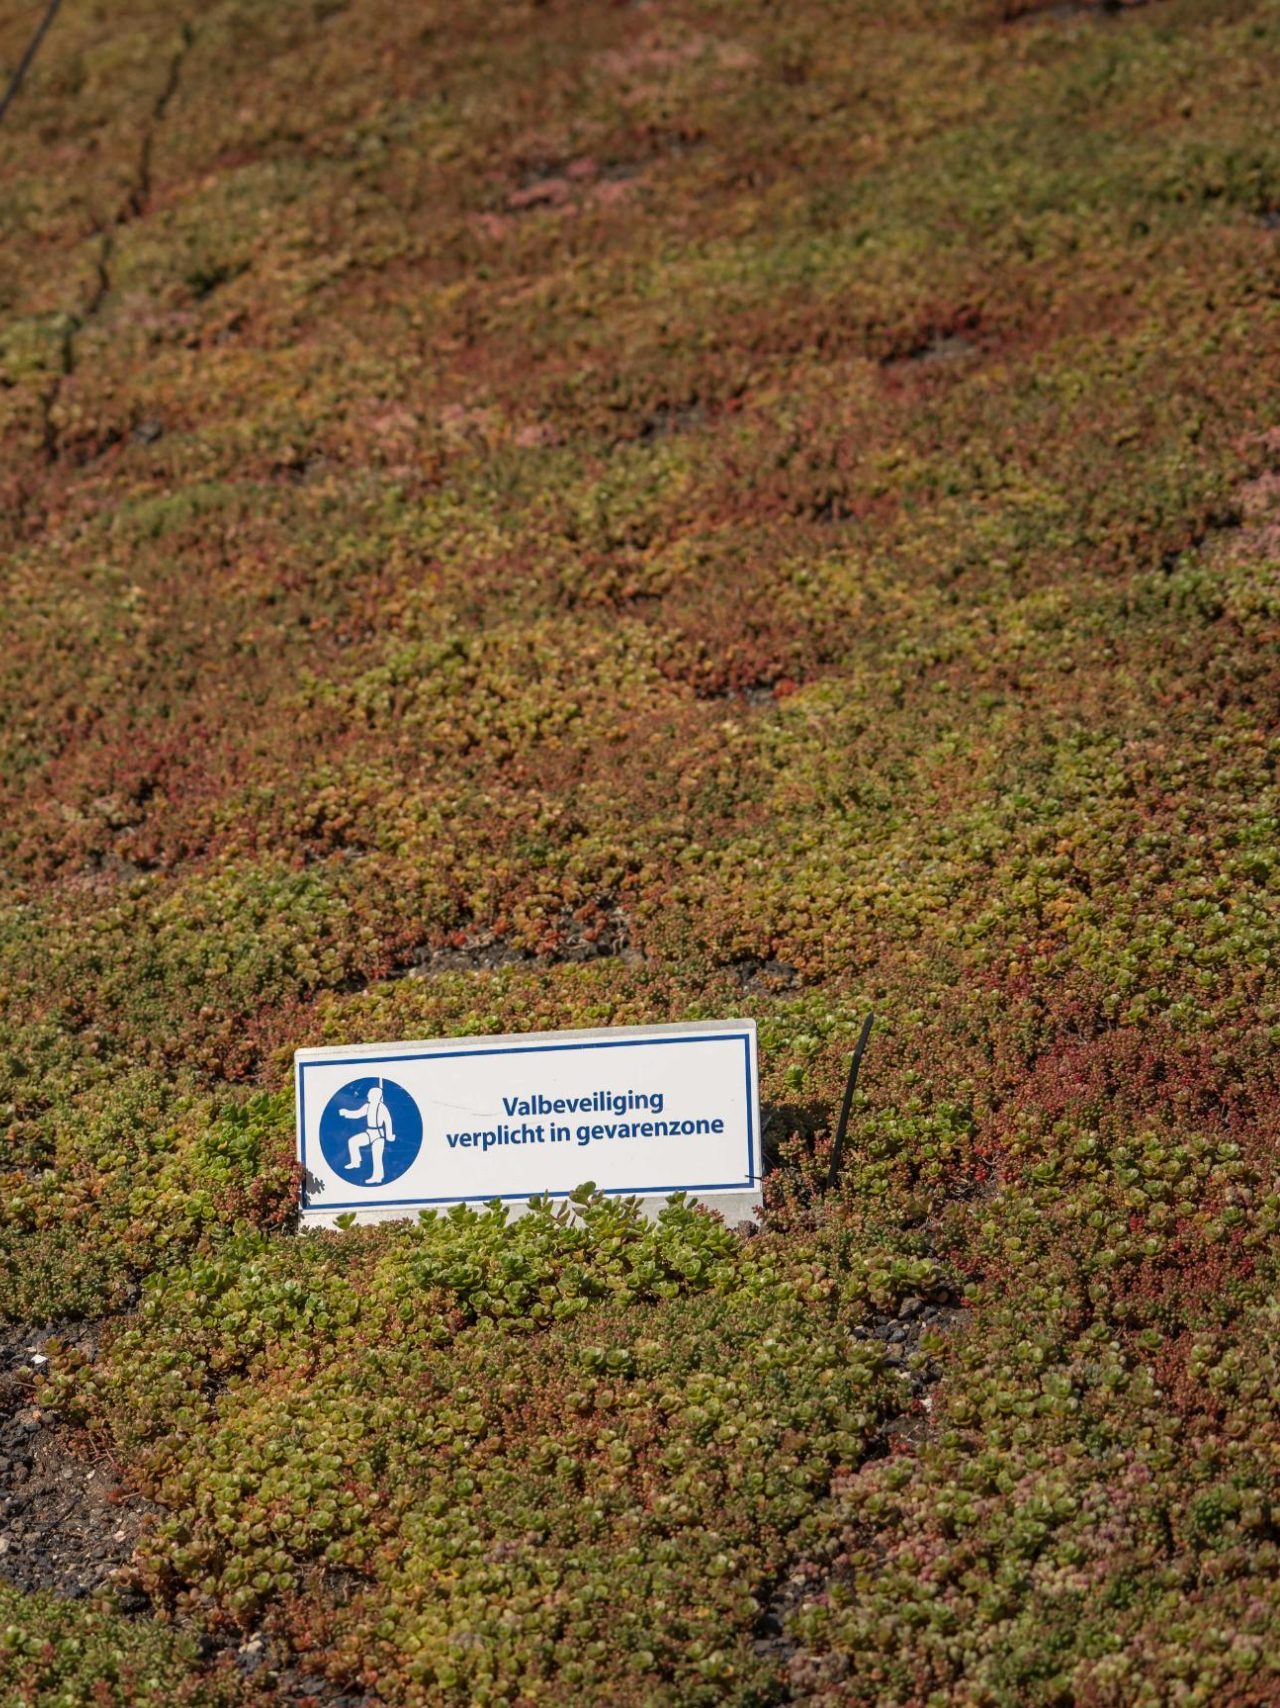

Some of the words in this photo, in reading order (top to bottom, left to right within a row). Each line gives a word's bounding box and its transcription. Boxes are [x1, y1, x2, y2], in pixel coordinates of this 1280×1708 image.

[502, 1089, 664, 1116] Valbeveiliging
[446, 1123, 545, 1151] verplicht
[550, 1122, 571, 1143] in
[576, 1118, 725, 1146] gevarenzone
